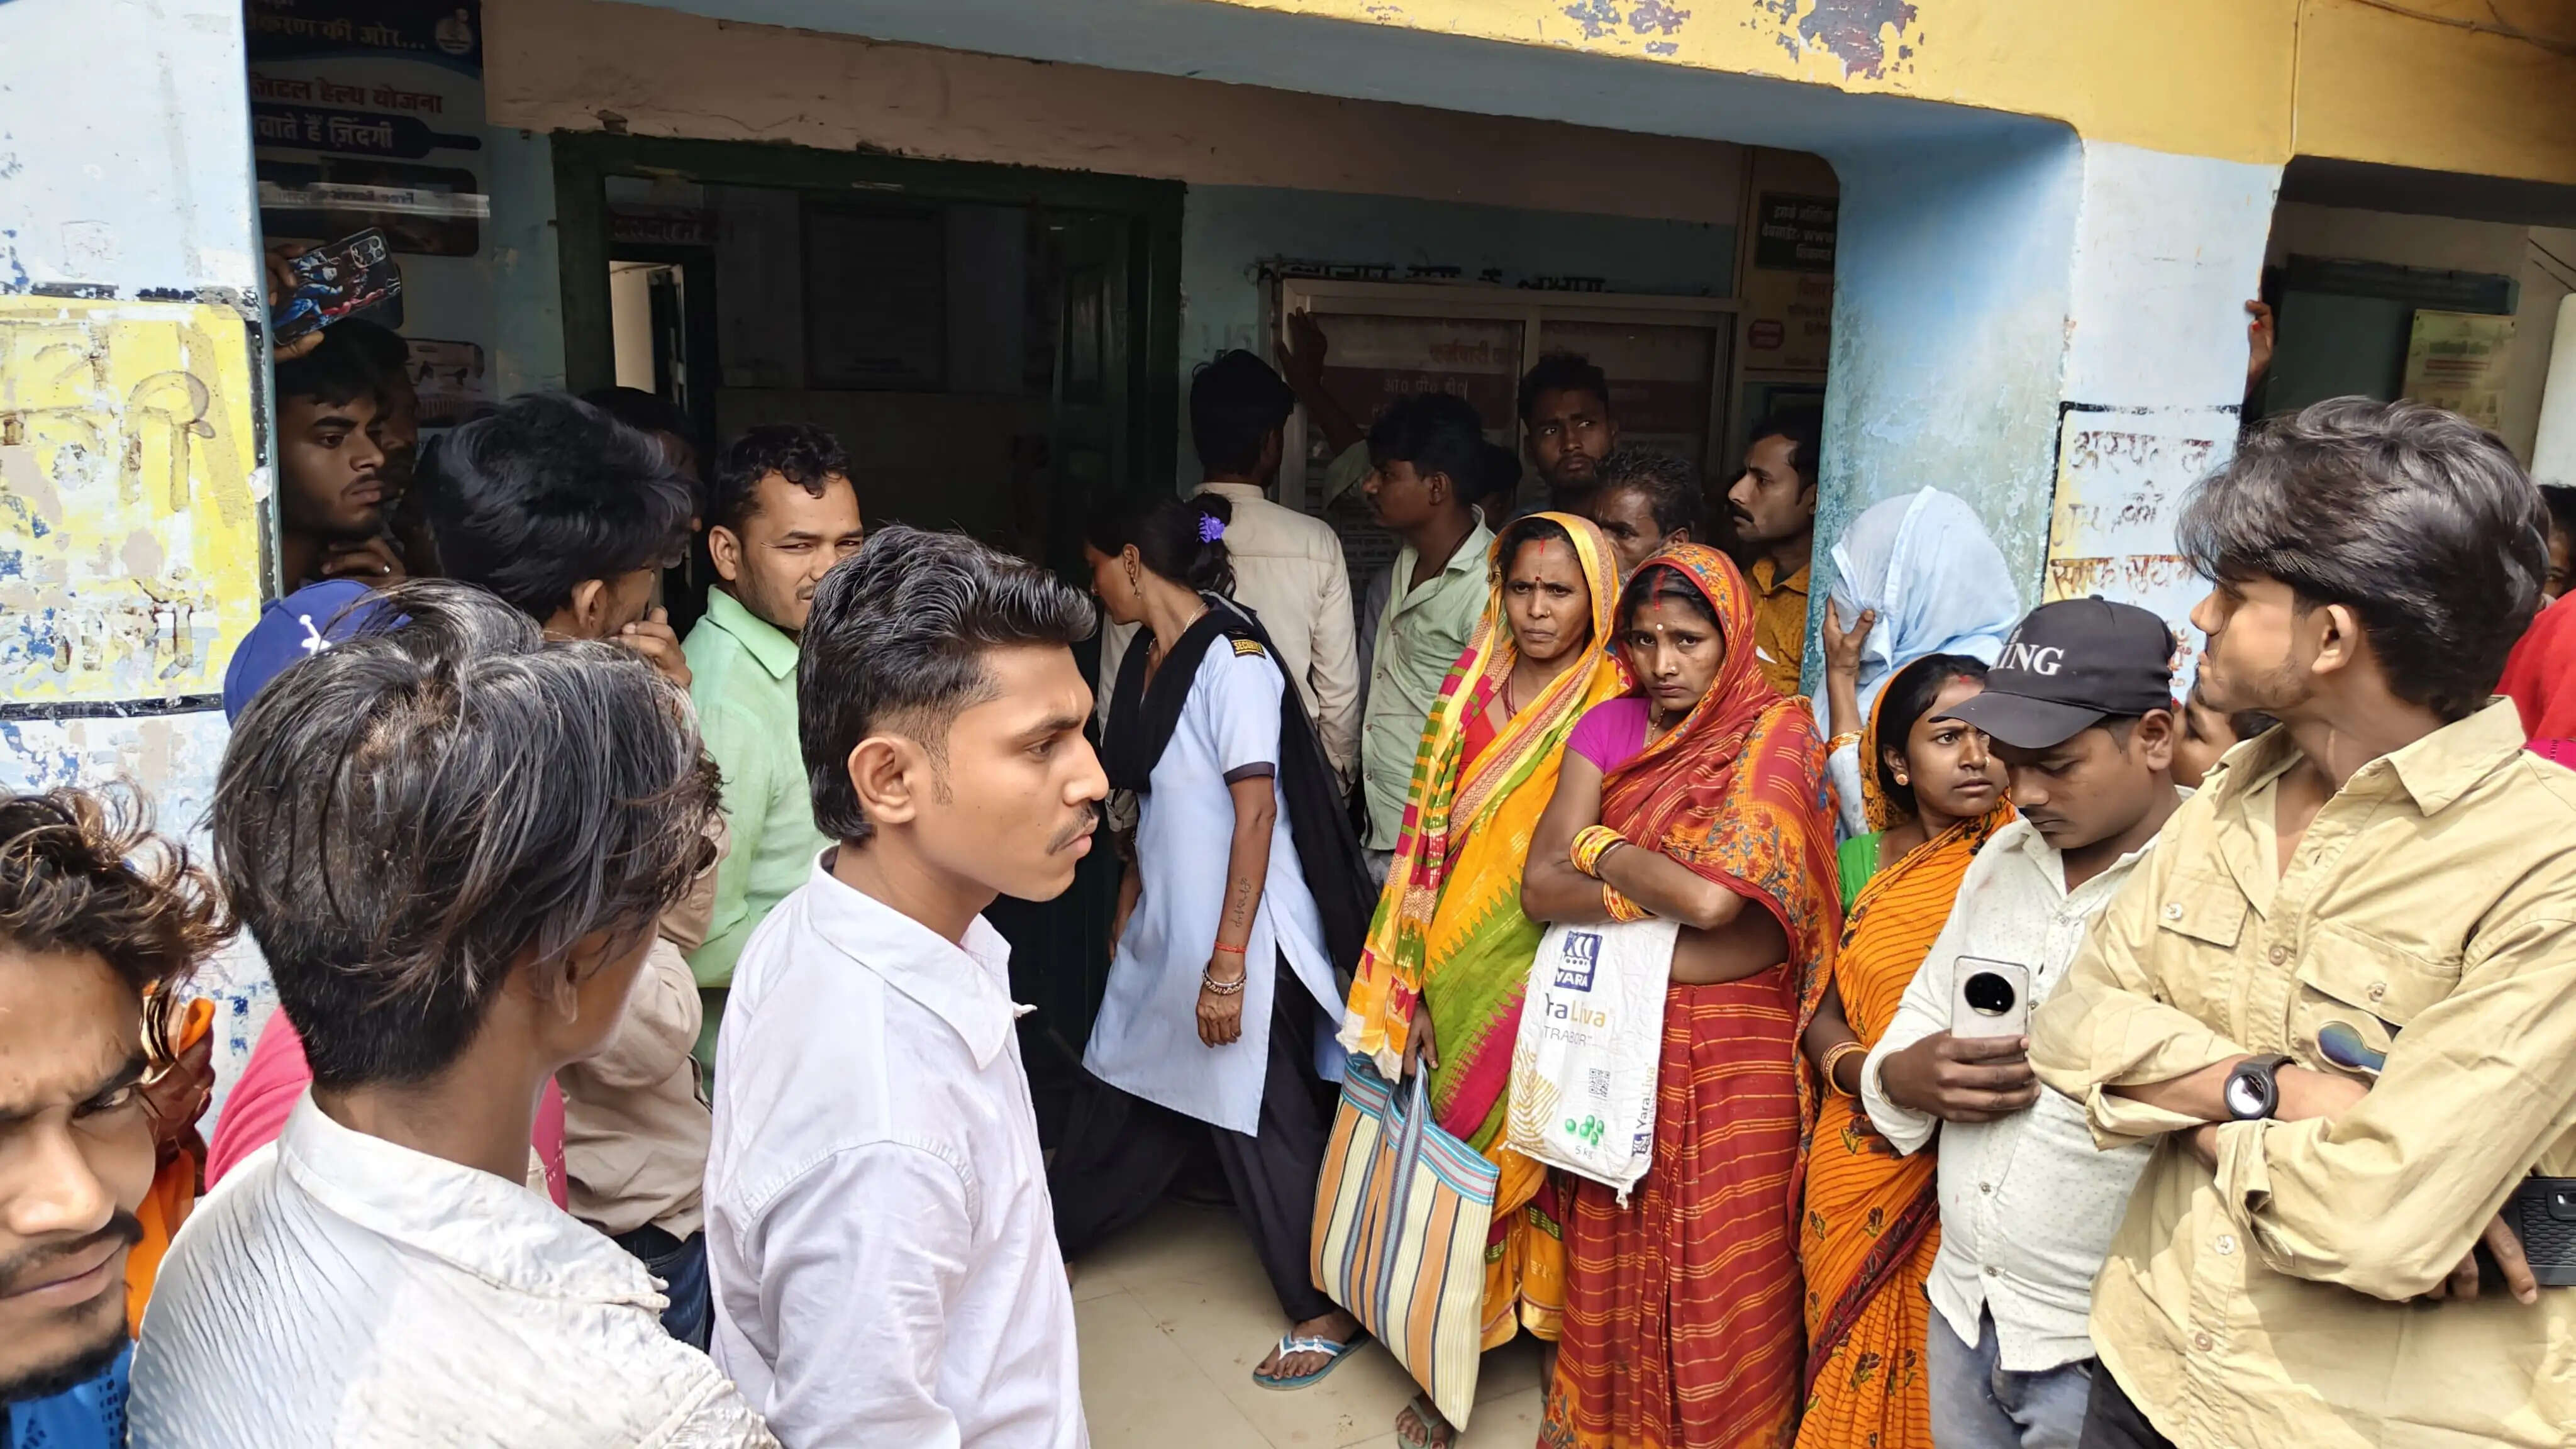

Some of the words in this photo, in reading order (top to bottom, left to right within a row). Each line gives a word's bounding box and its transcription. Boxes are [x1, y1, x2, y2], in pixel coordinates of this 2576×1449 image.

[247, 8, 318, 38] करण
[319, 17, 352, 42] की
[250, 72, 313, 100] जिटल
[372, 83, 443, 114] योजना
[1575, 1145, 1580, 1155] 5
[1583, 1147, 1594, 1160] kg
